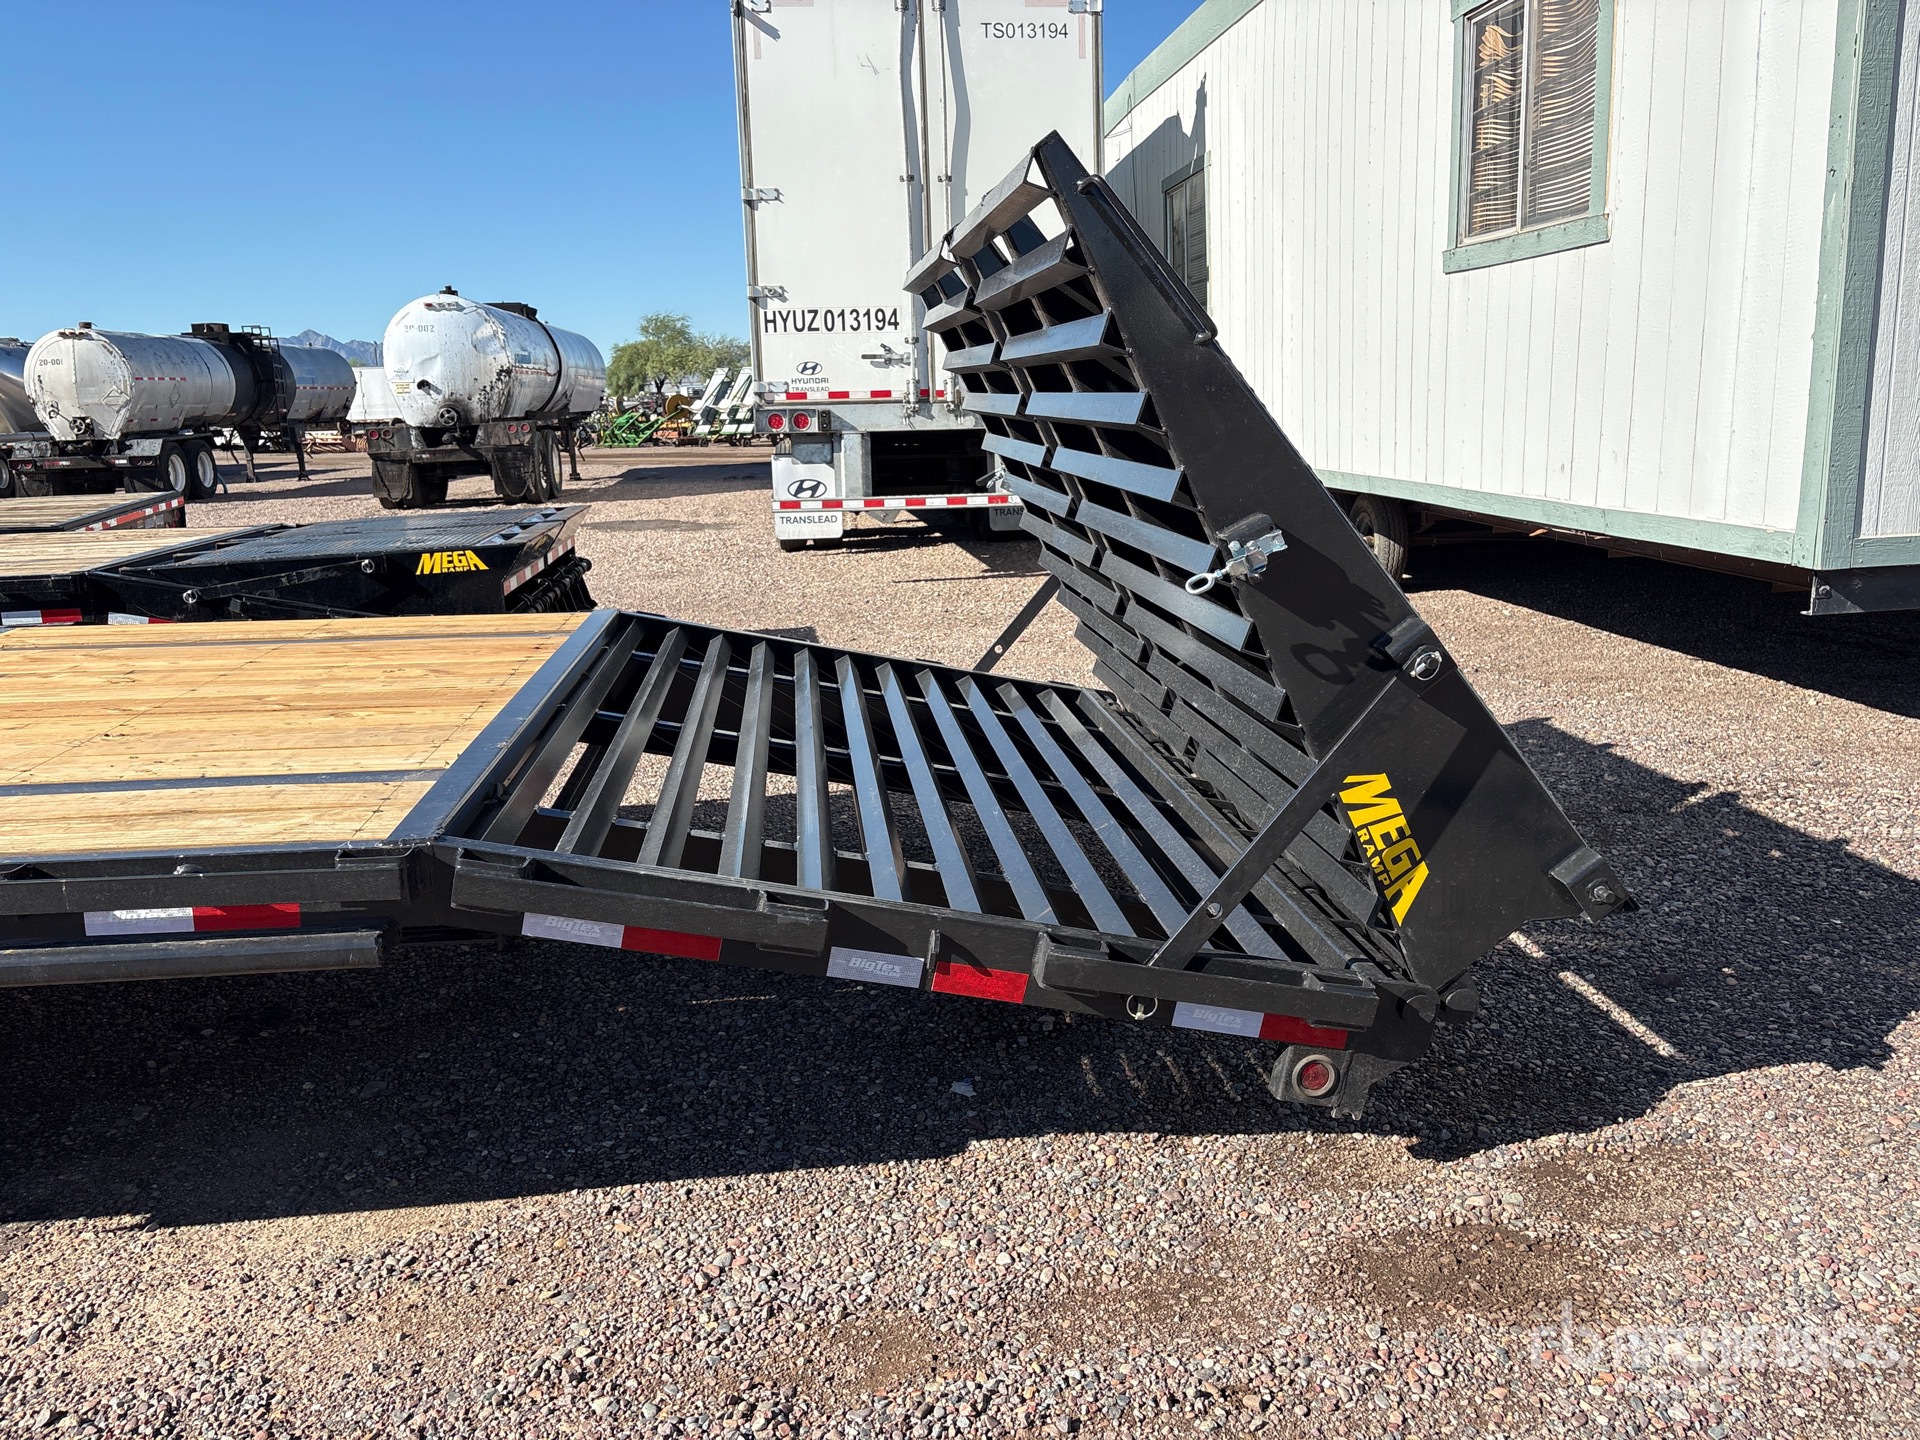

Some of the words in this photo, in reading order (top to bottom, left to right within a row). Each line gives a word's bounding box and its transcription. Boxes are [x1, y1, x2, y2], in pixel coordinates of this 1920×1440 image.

[981, 22, 1069, 40] TS013194
[38, 358, 63, 366] 20-001
[791, 377, 829, 385] HYUNDAI
[779, 514, 838, 526] TRANSLEAD
[415, 549, 490, 576] MEGA
[1338, 772, 1430, 928] MEGA
[1356, 827, 1391, 887] RAMP
